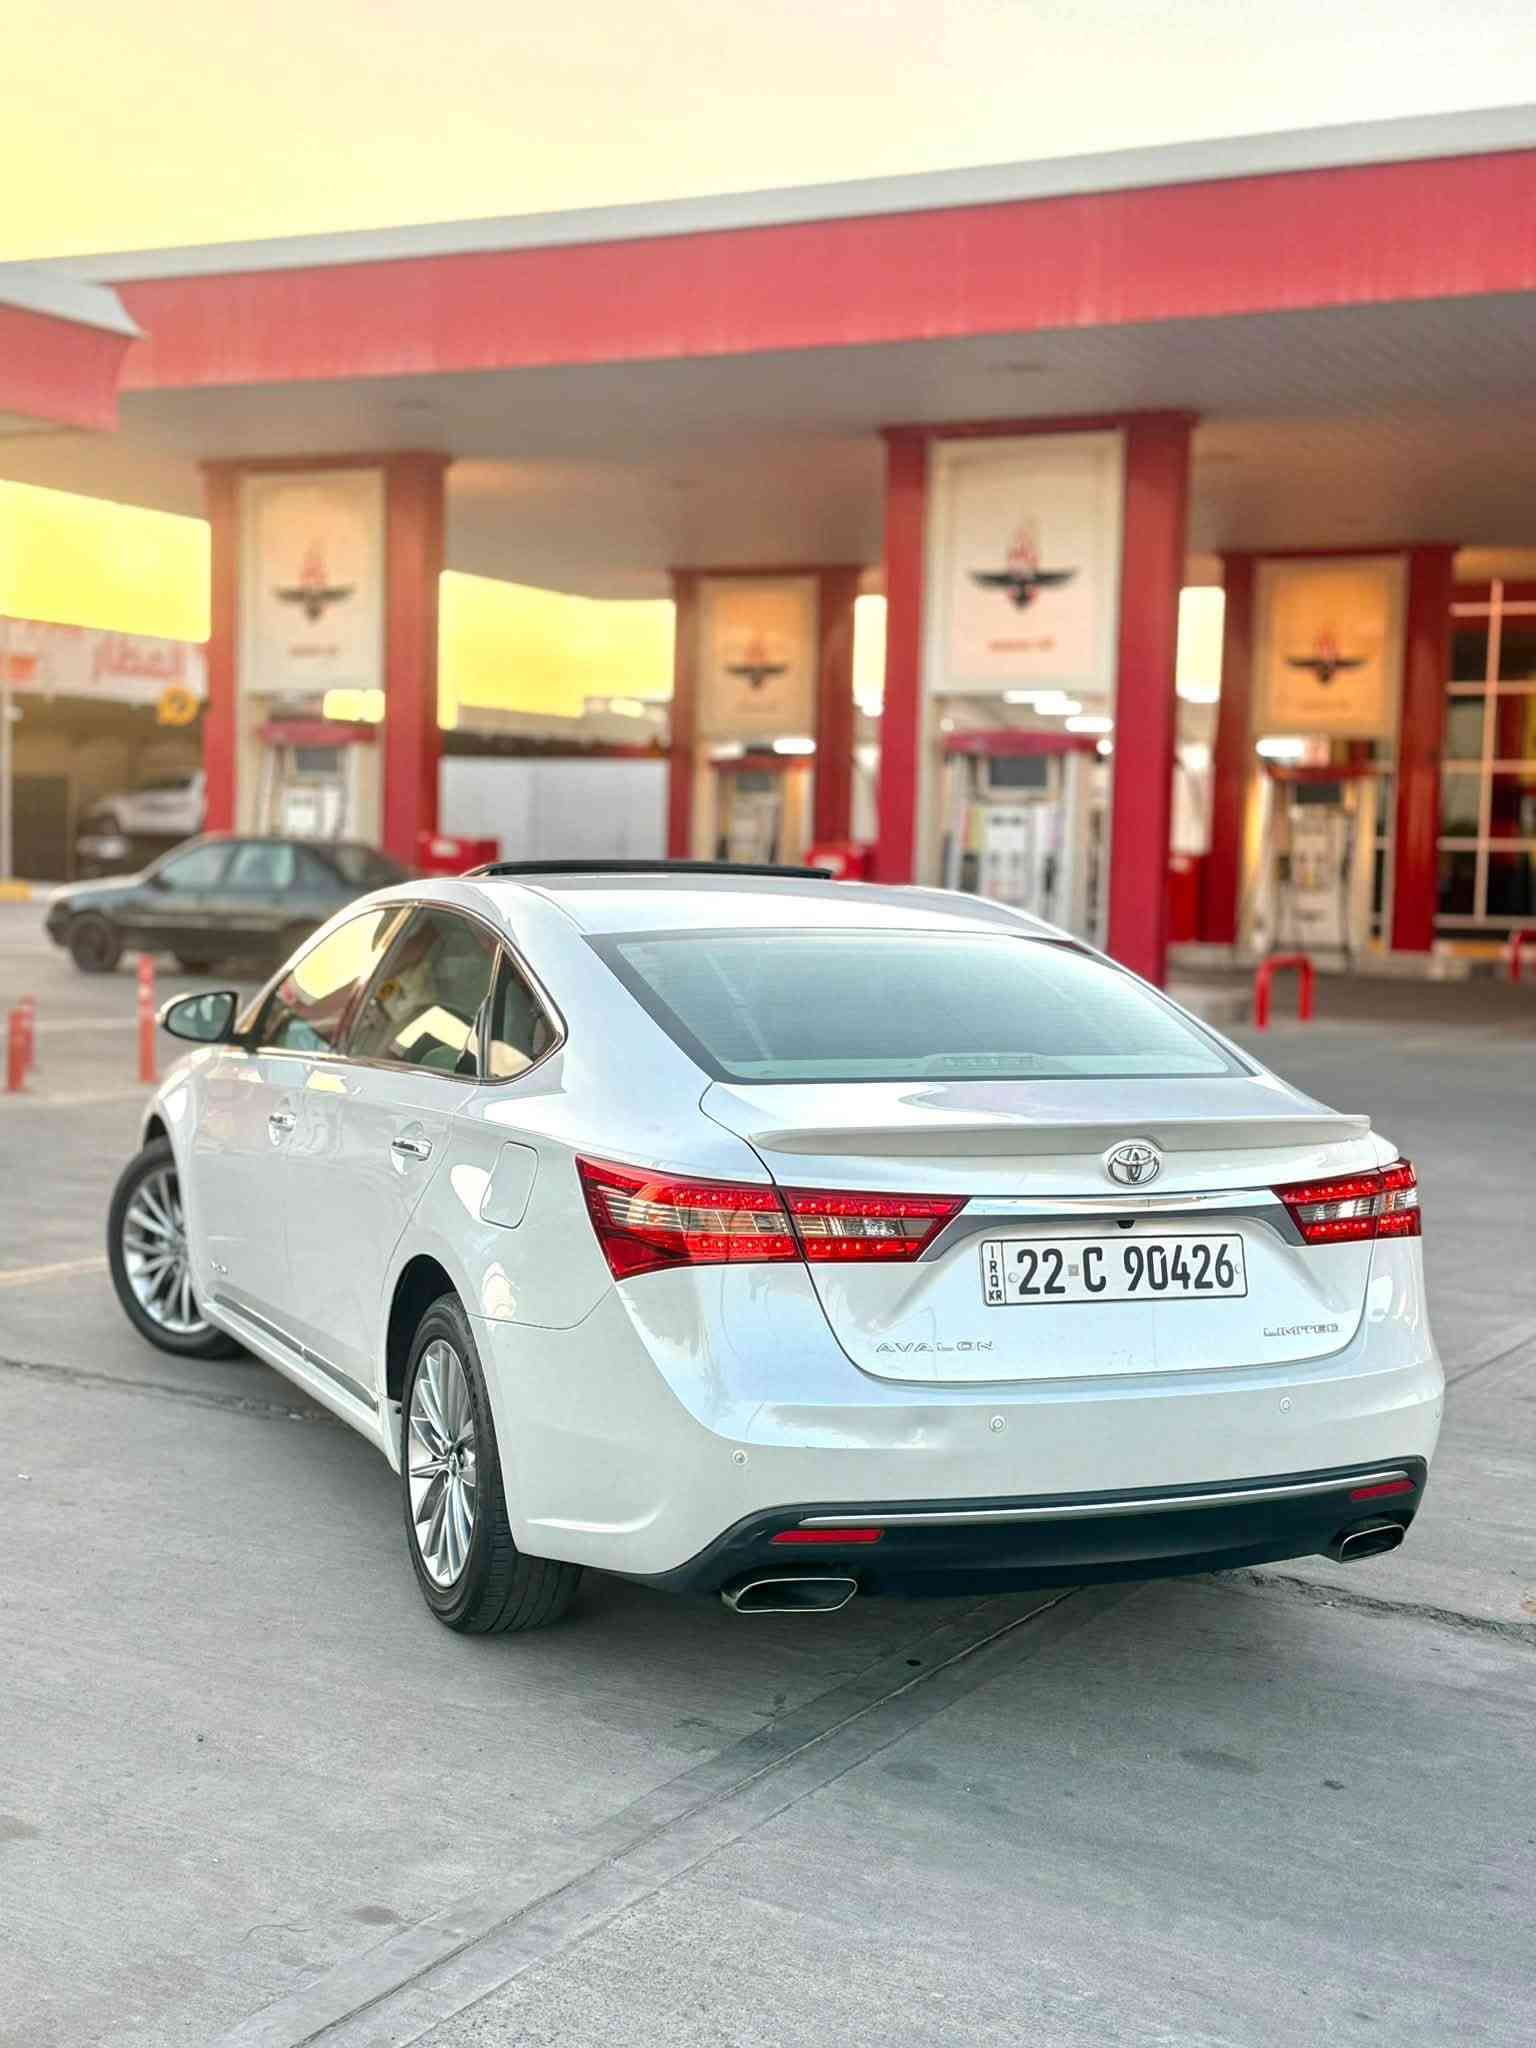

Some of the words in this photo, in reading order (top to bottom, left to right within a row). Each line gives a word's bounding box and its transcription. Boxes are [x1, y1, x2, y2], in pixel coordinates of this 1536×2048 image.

[1017, 1248, 1066, 1295] 22
[1083, 1247, 1107, 1293] C
[1123, 1243, 1235, 1292] 90426
[1263, 1323, 1339, 1337] LIMITED
[876, 1341, 994, 1353] AVALON
